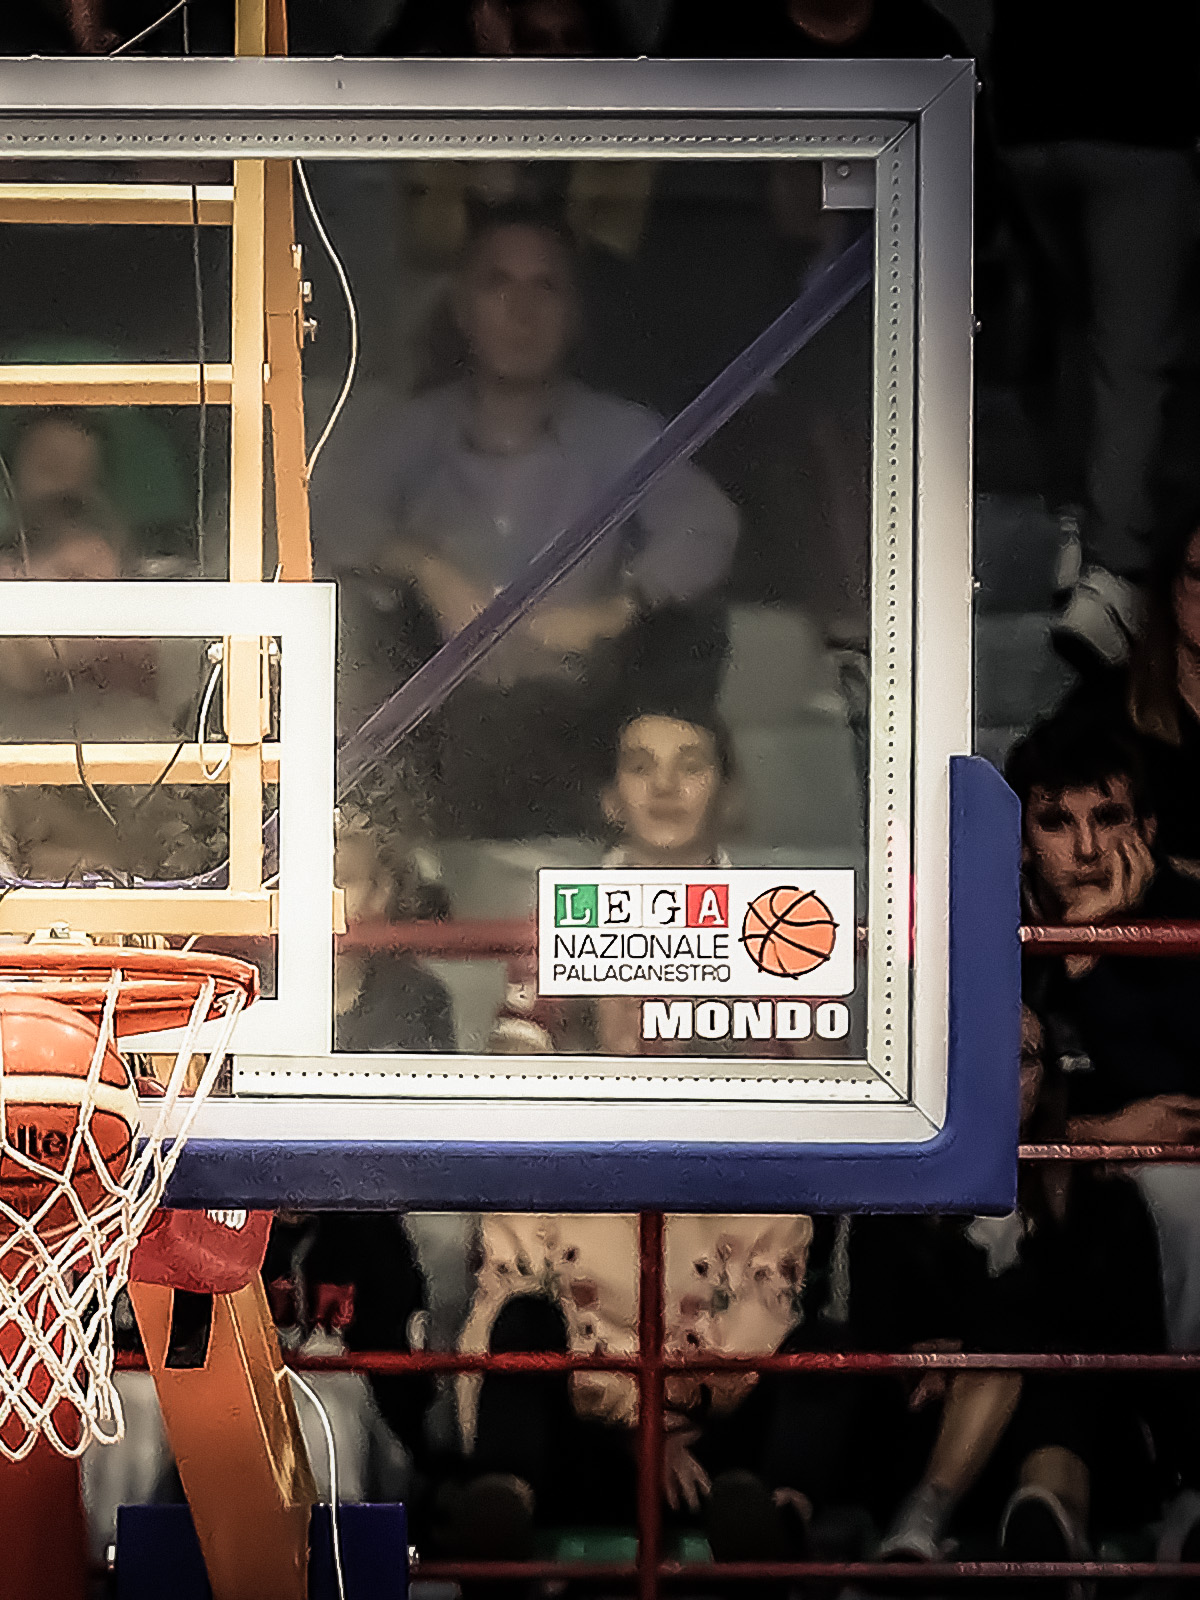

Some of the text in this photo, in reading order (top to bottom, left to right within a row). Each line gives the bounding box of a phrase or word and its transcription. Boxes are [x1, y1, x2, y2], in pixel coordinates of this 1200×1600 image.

[556, 887, 727, 926] LEGA
[553, 933, 730, 960] NAZIONALE
[553, 963, 731, 983] PALLACANESTRO
[642, 1000, 850, 1040] MONDO
